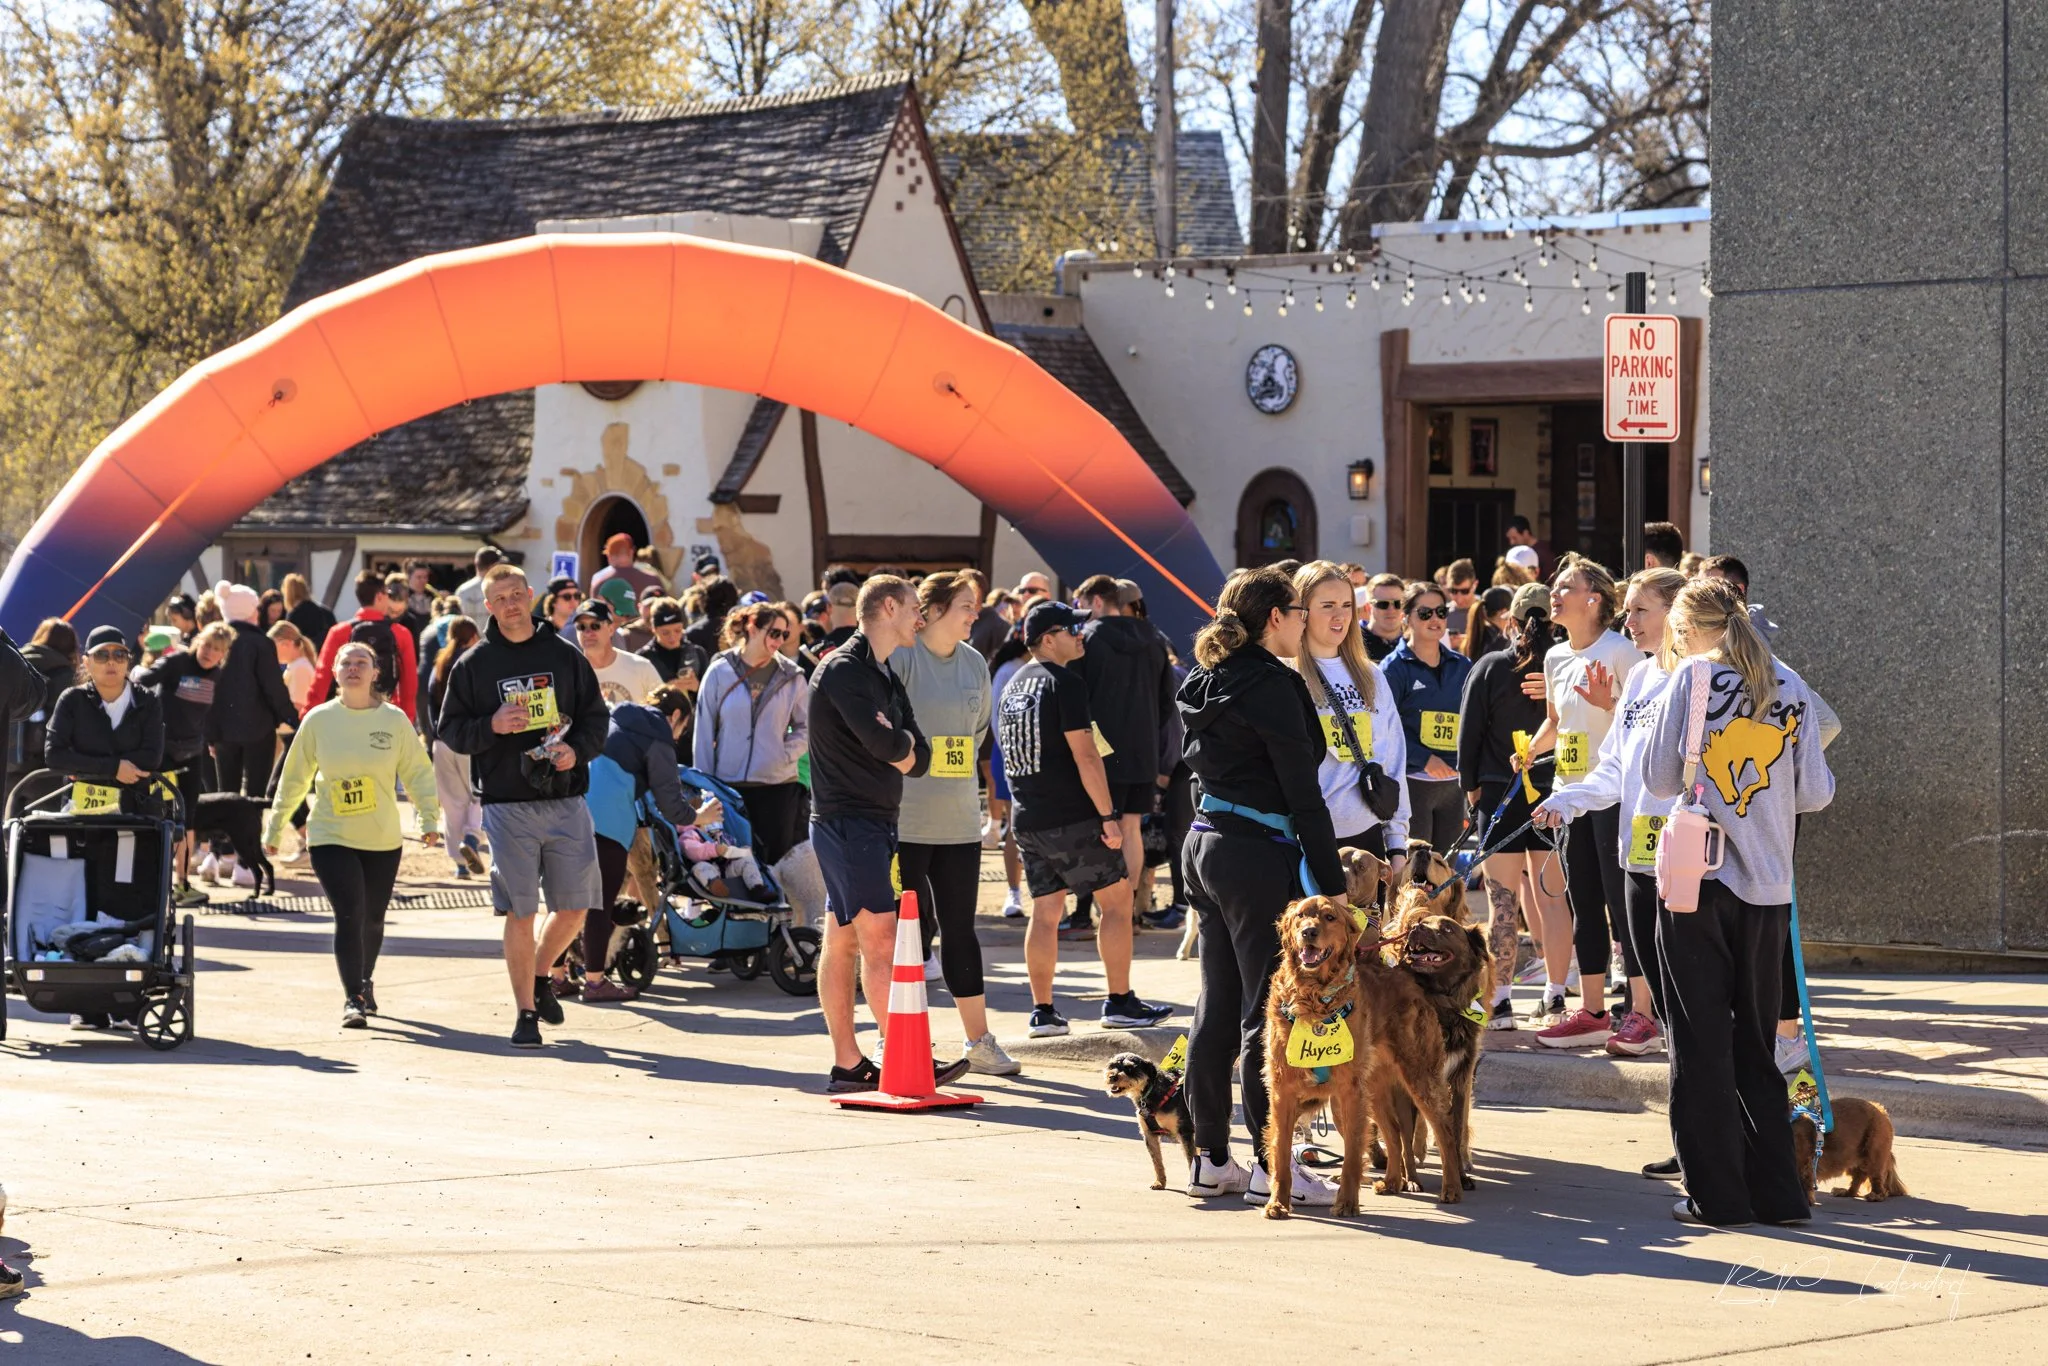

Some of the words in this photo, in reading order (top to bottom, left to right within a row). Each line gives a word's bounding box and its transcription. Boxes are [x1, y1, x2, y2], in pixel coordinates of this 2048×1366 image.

[1630, 328, 1655, 350] NO
[1611, 355, 1673, 378] PARKING
[1628, 381, 1656, 397] ANY
[1627, 400, 1658, 415] TIME
[532, 692, 543, 701] 5K
[1003, 693, 1029, 712] Ford
[528, 703, 545, 718] 76
[1446, 714, 1455, 724] 5K
[1433, 725, 1454, 740] 375
[1569, 735, 1578, 745] 5K
[956, 738, 965, 747] 5K
[945, 750, 964, 766] 153
[353, 779, 363, 788] 5K
[344, 790, 363, 805] 477
